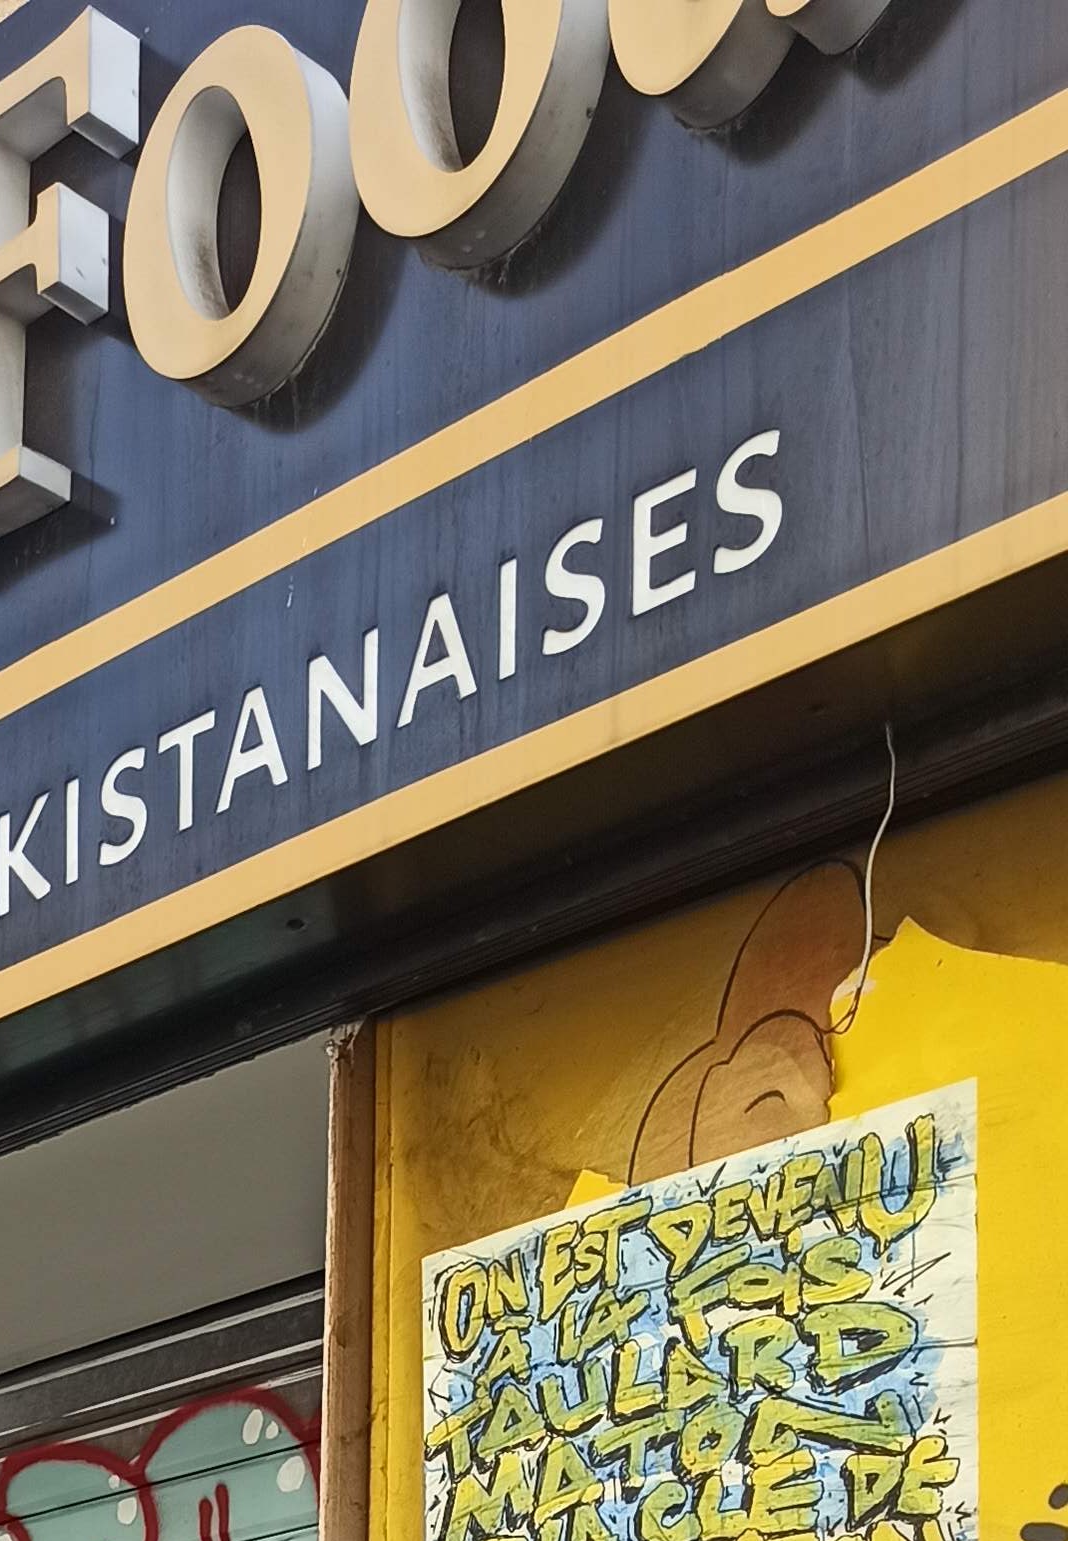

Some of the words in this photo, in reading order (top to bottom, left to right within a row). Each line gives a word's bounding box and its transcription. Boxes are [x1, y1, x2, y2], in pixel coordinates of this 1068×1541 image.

[437, 1250, 532, 1364] ON
[536, 1197, 654, 1325] EST
[645, 1113, 936, 1285] DEVENU
[425, 1300, 920, 1481] TAULARD
